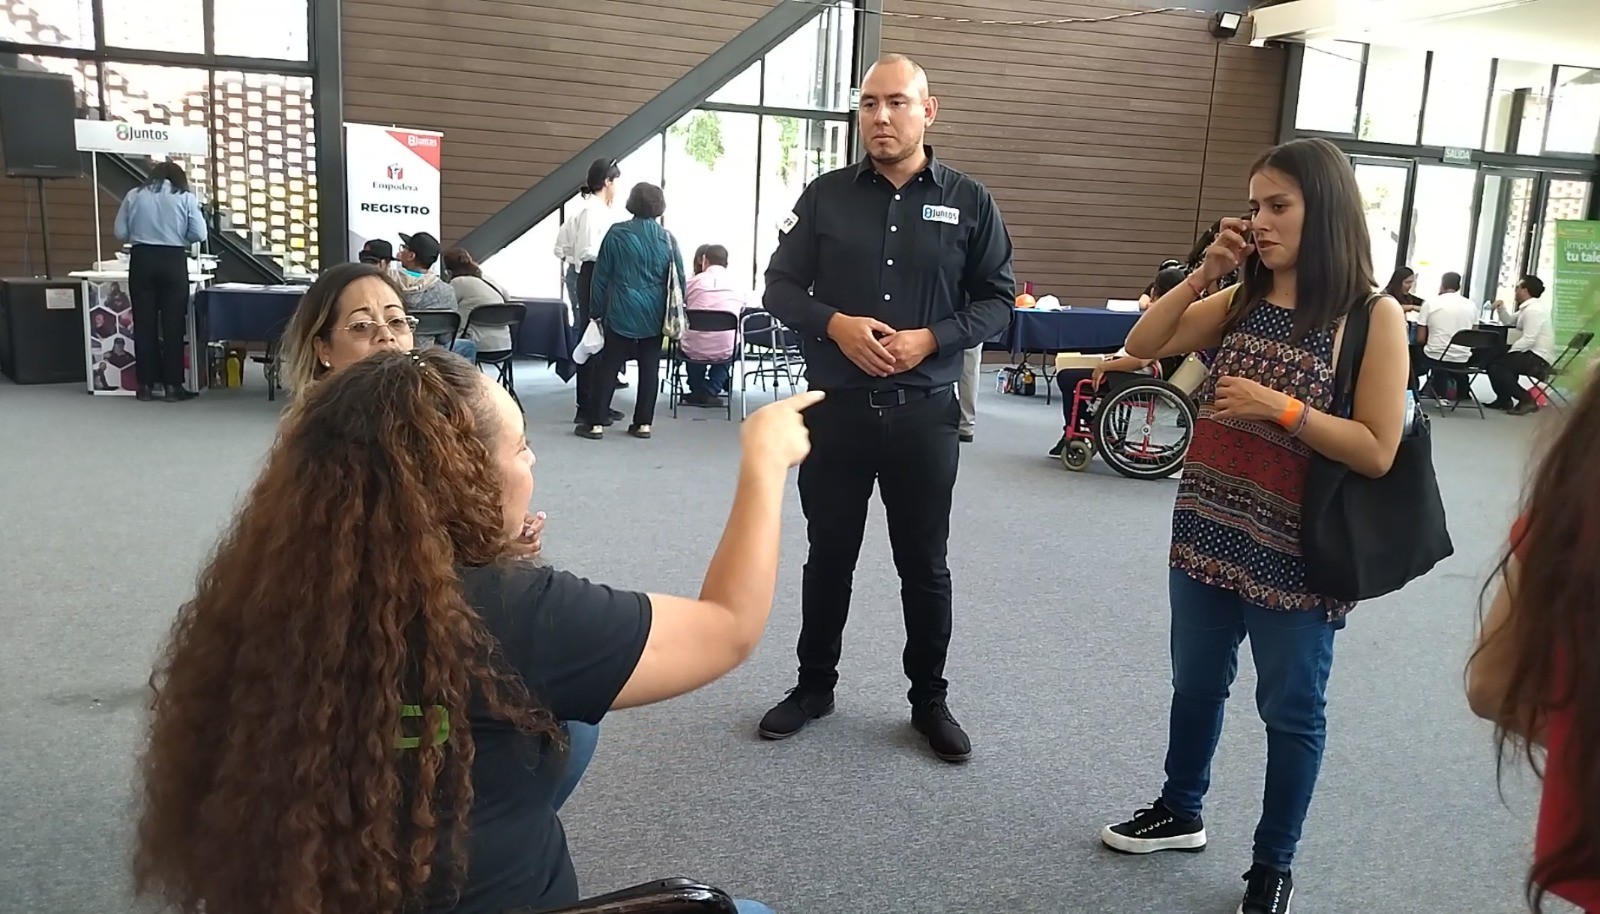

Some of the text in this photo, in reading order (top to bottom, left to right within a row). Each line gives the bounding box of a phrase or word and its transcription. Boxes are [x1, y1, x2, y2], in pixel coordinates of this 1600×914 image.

[1445, 149, 1470, 160] SALIDA
[372, 181, 419, 192] Empodera
[360, 202, 431, 216] REGISTRO
[1566, 251, 1579, 262] tu
